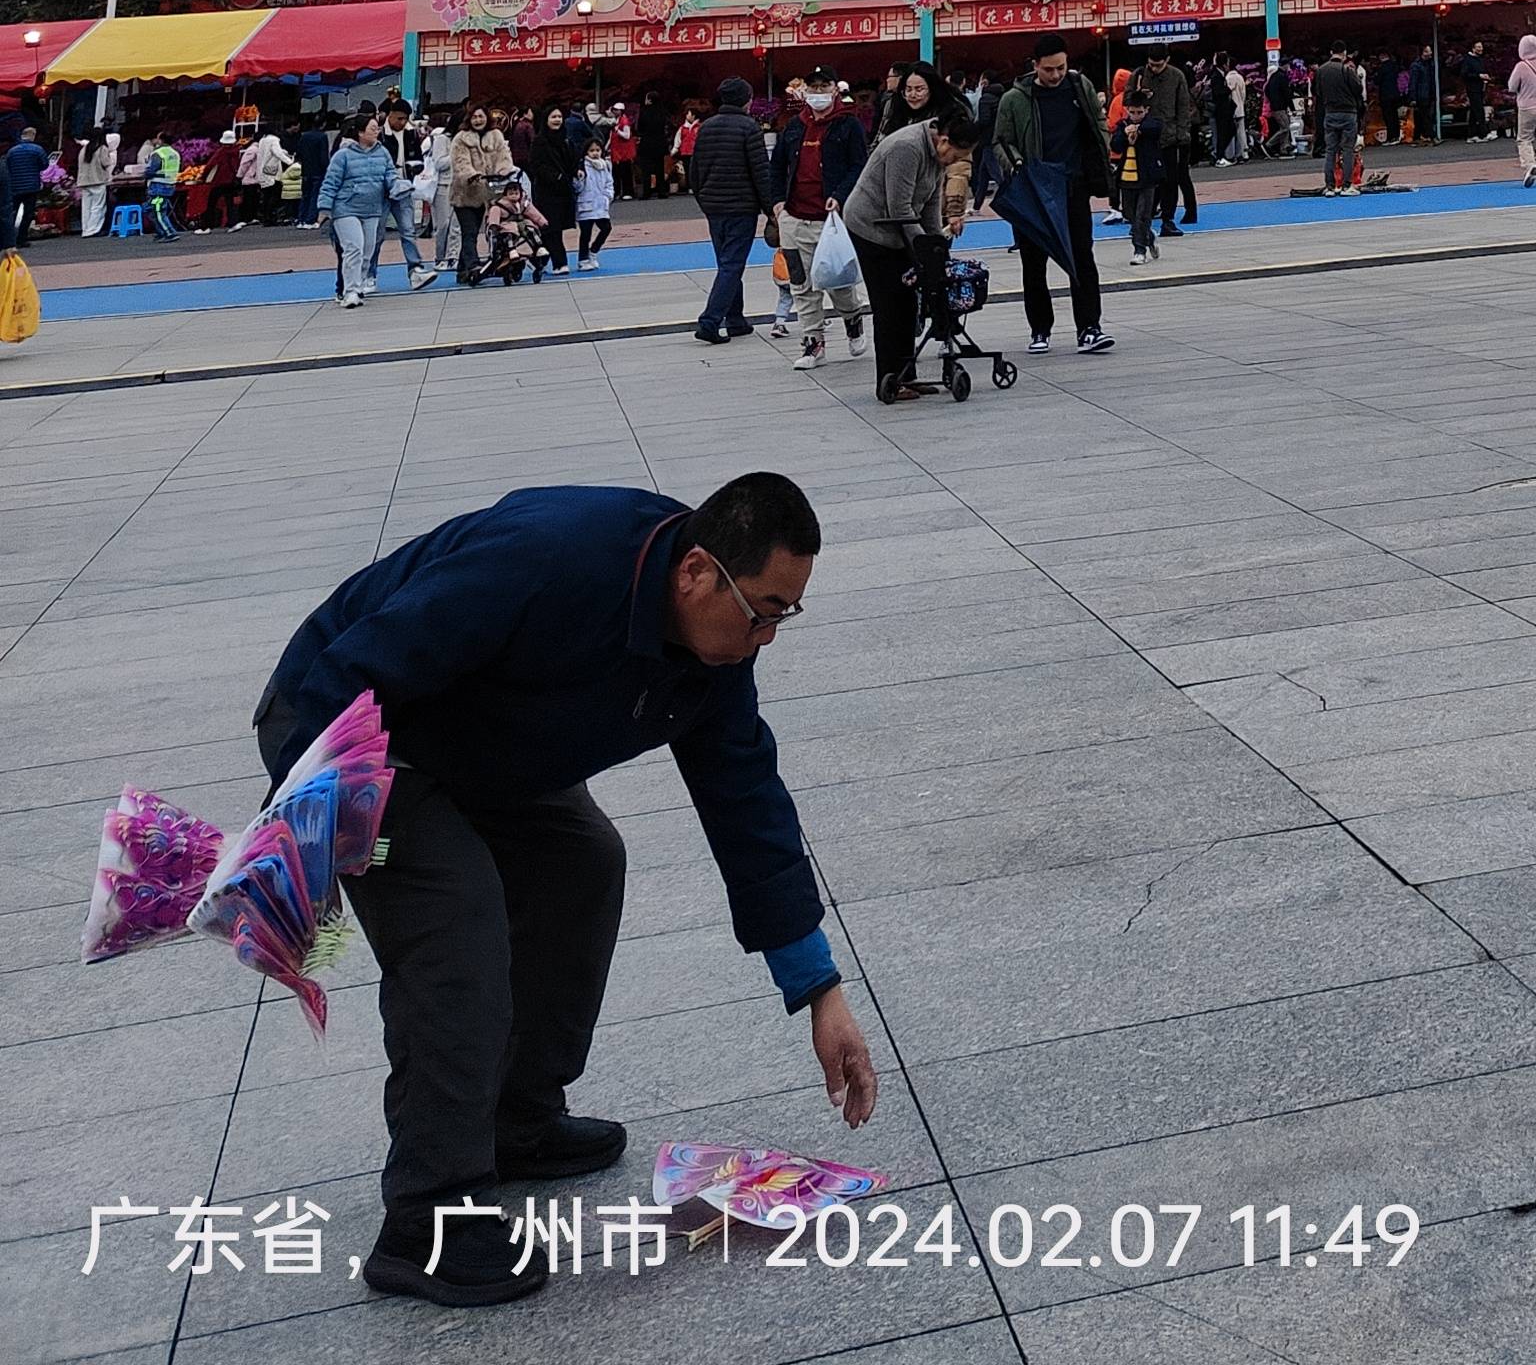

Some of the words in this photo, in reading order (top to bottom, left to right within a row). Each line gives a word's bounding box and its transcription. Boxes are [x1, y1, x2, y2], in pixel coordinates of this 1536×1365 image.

[985, 7, 1050, 26] 花开富贵
[471, 35, 540, 54] 繁花似锦
[641, 27, 707, 46] 春暖花开
